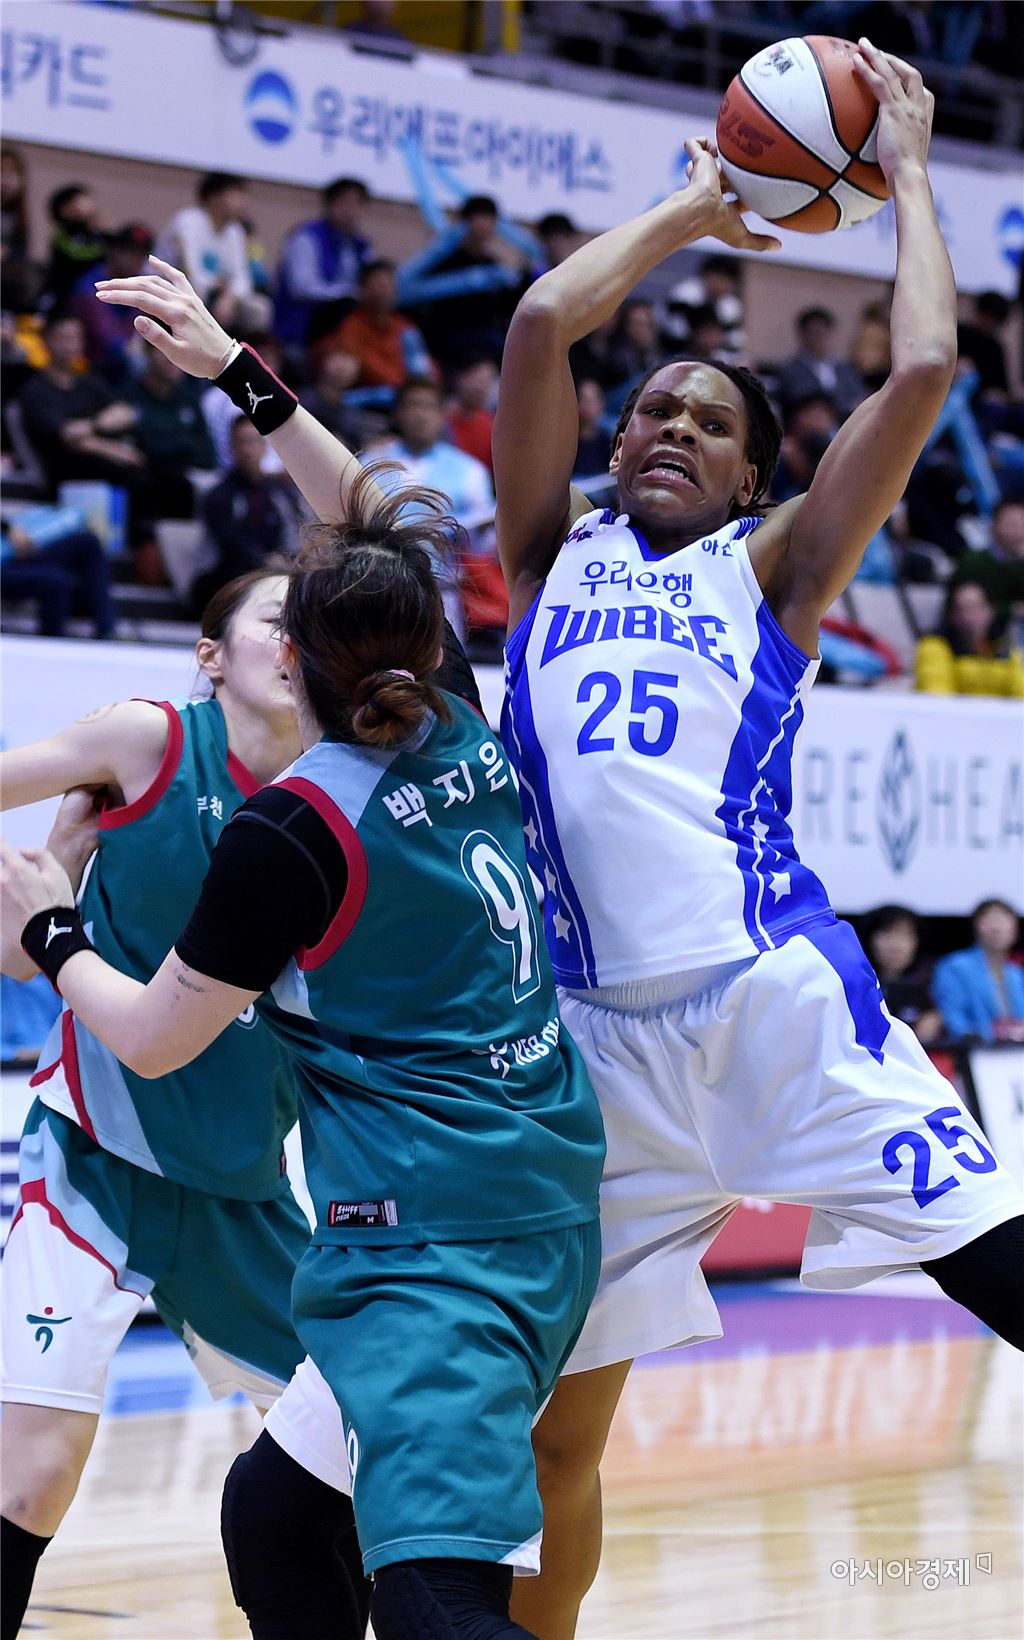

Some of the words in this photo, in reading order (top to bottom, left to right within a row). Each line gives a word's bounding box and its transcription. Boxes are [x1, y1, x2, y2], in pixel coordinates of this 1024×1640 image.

[579, 561, 692, 608] 우리은행
[539, 604, 738, 682] WIBEE
[576, 669, 679, 757] 25
[197, 796, 223, 820] 부천
[464, 834, 538, 998] 9
[882, 1106, 997, 1209] 25
